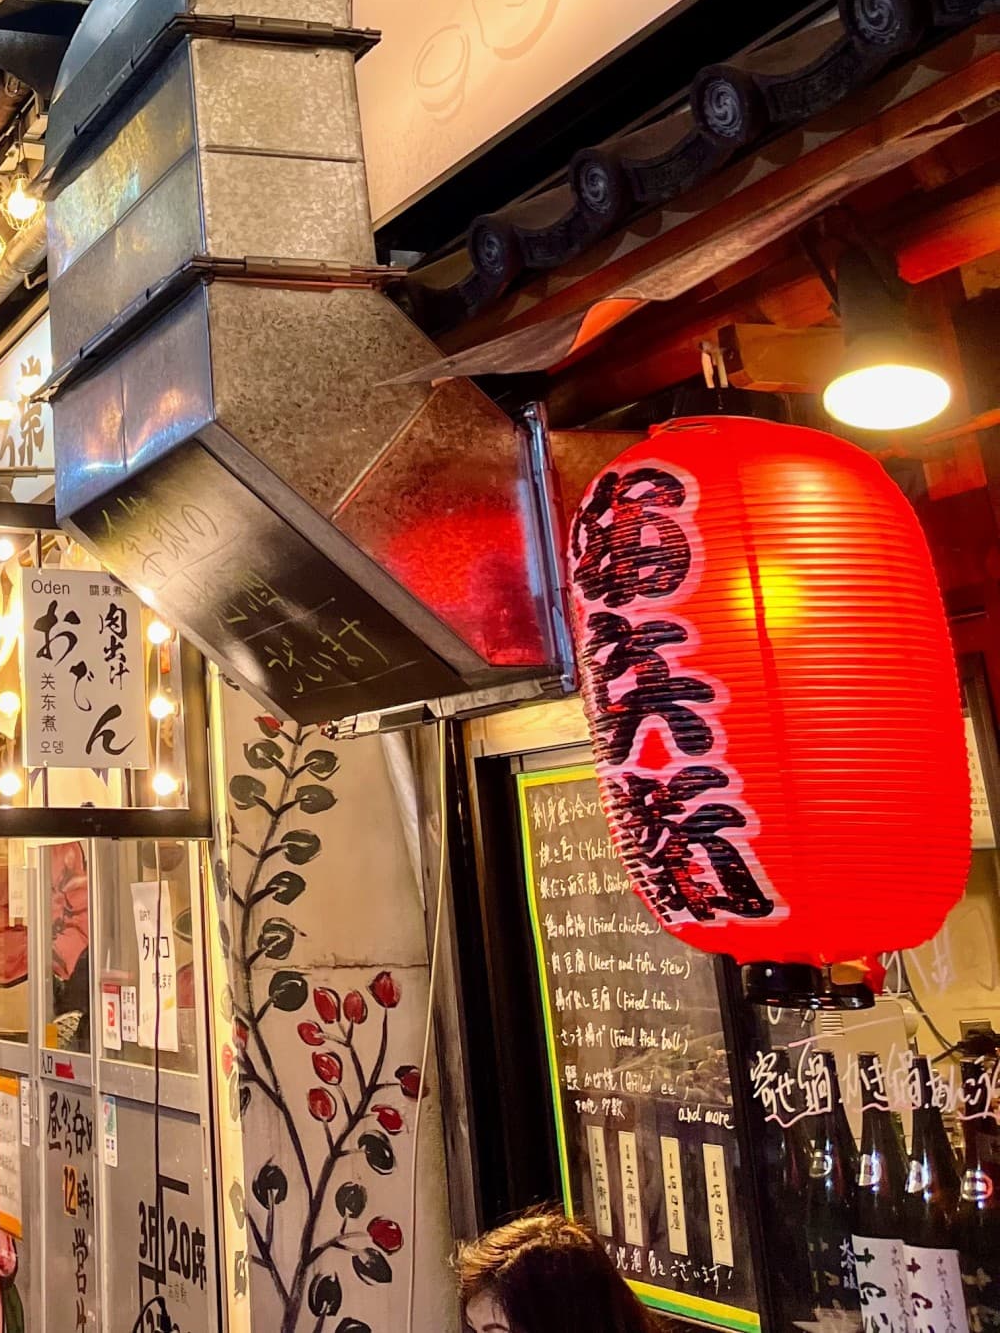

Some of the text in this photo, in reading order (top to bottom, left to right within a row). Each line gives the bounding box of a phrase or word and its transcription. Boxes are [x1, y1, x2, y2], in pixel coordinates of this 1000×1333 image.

[31, 579, 70, 595] Oden
[40, 673, 57, 733] 关东煮
[678, 1104, 702, 1123] and
[705, 1110, 735, 1129] more
